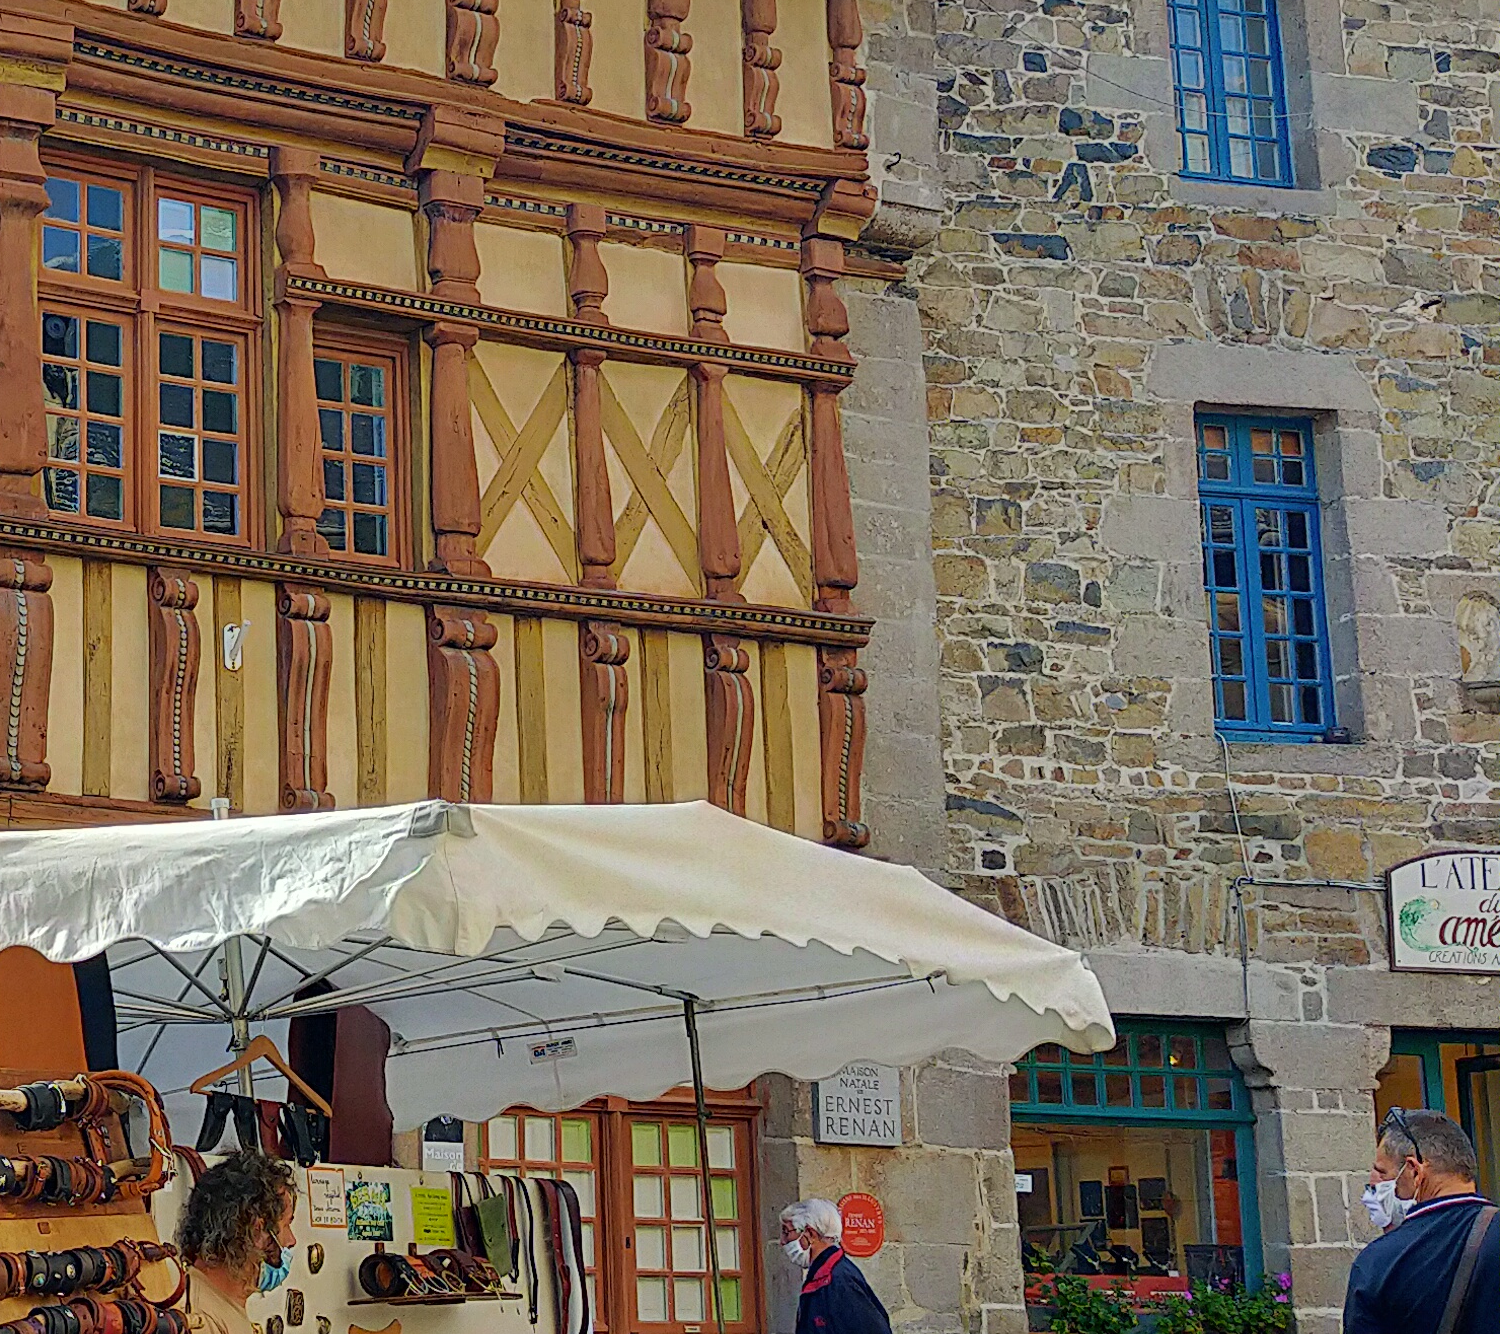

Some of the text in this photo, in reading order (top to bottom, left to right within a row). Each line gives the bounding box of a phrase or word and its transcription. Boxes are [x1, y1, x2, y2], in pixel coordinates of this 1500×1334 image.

[840, 1078, 880, 1090] NATALE
[825, 1095, 893, 1116] ERNEST
[826, 1116, 895, 1138] RENAN
[425, 1148, 461, 1160] Maison
[845, 1217, 875, 1229] RENAN
